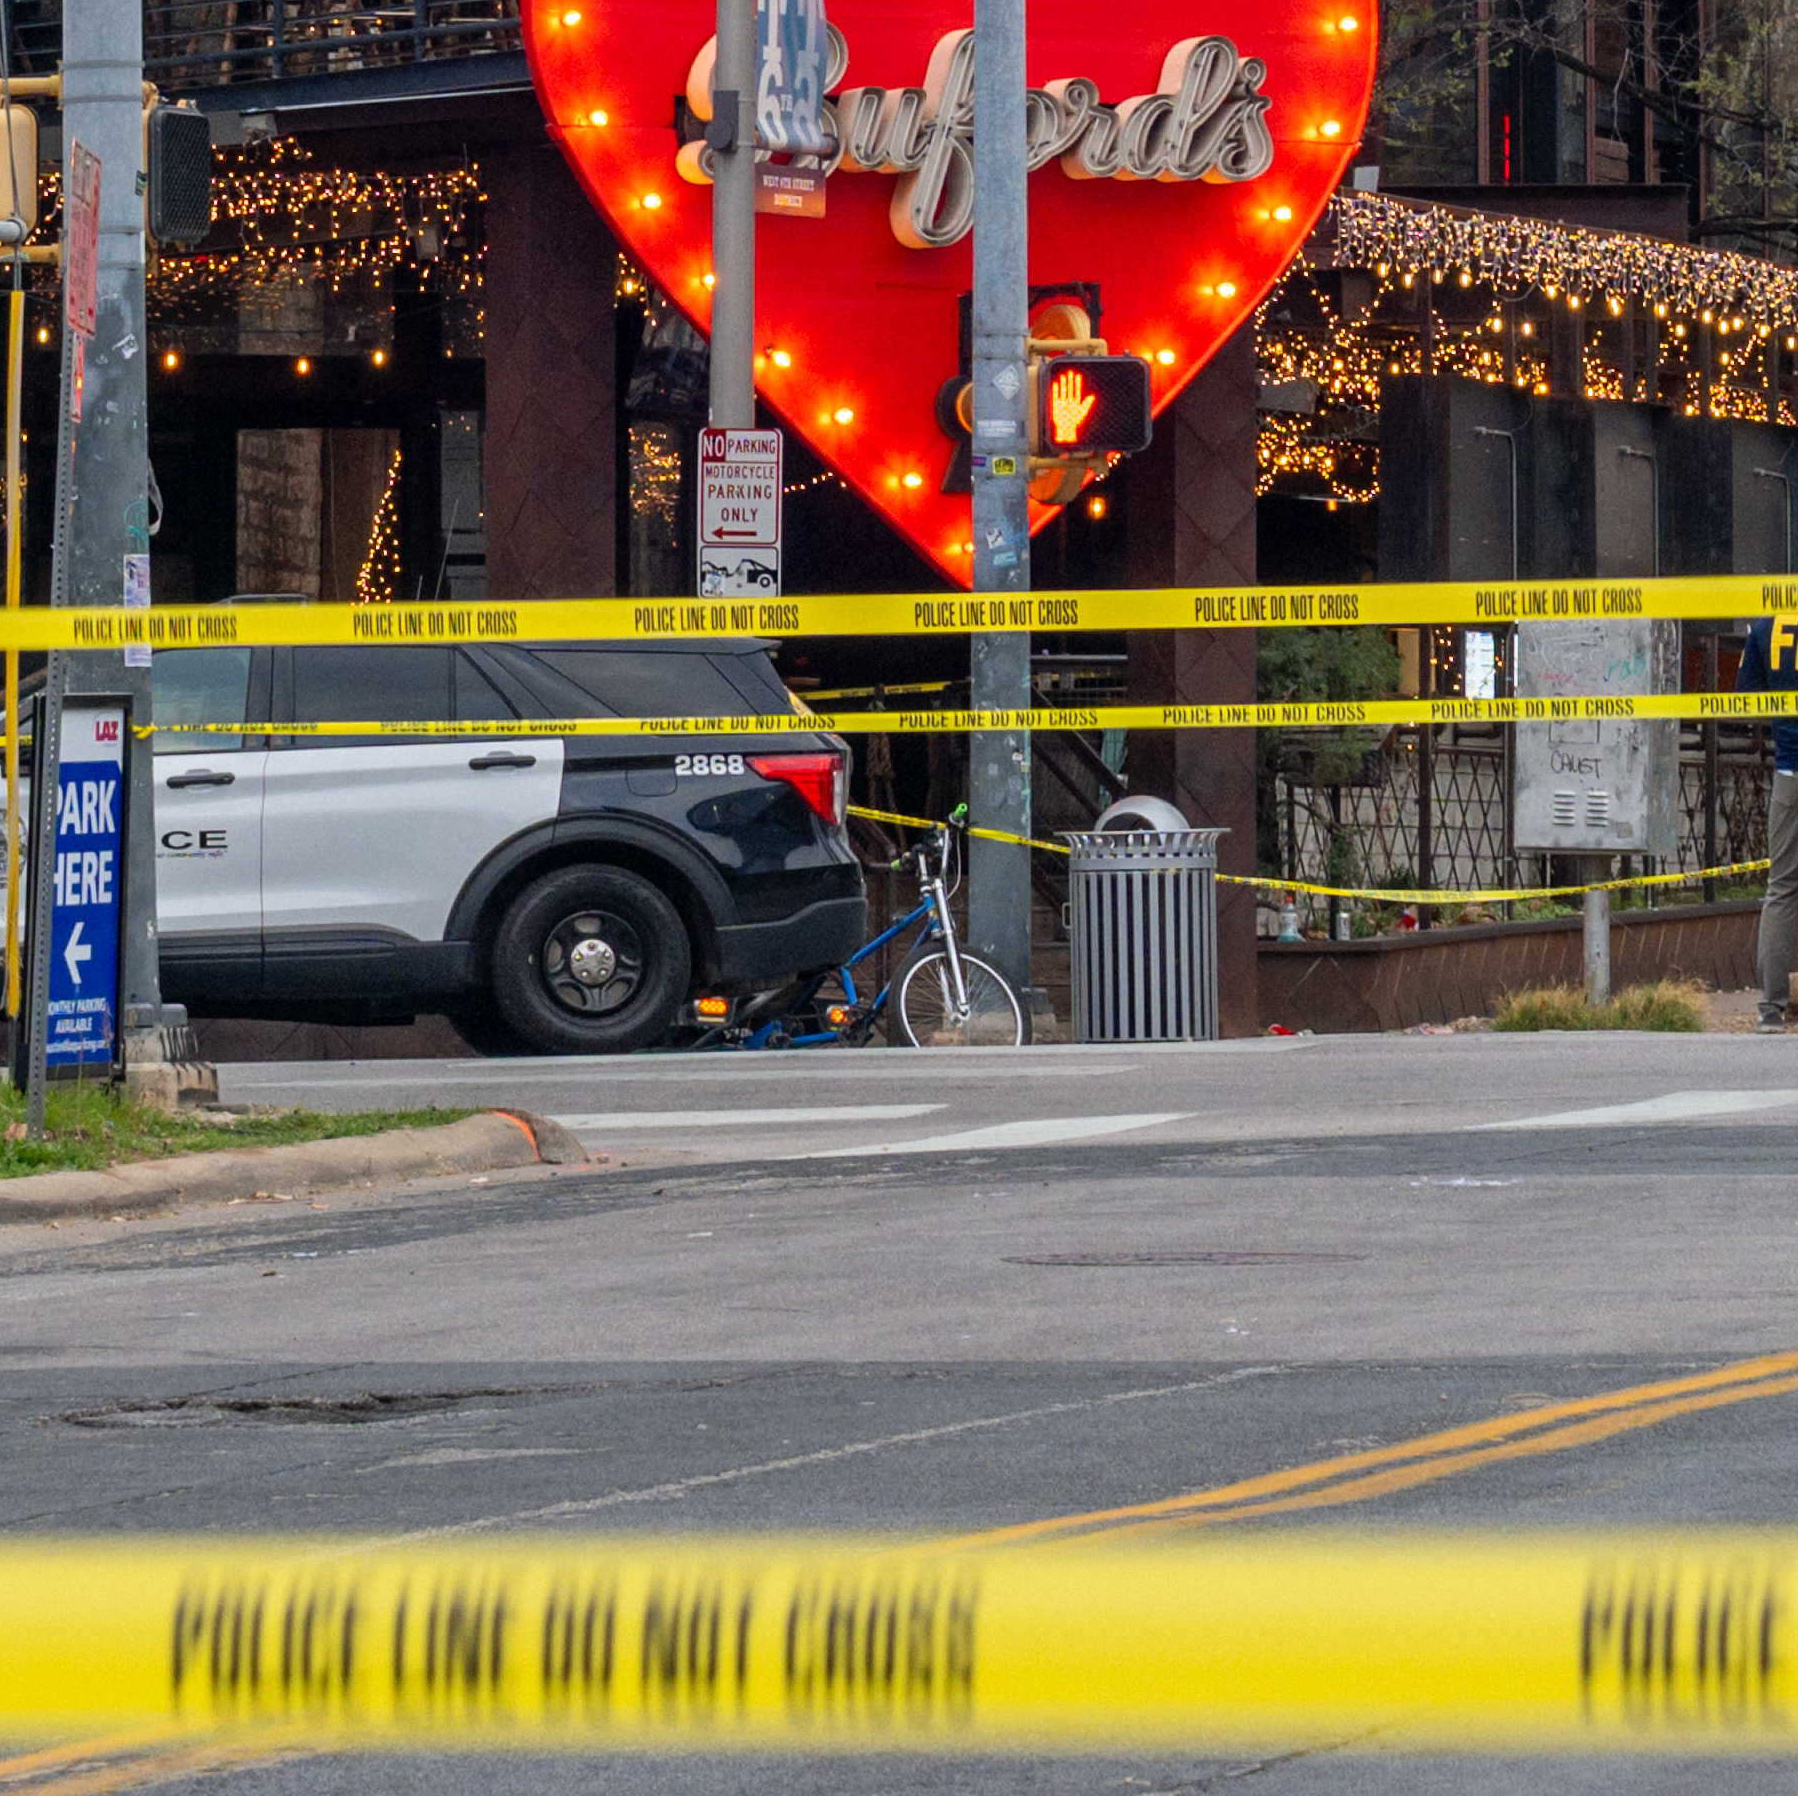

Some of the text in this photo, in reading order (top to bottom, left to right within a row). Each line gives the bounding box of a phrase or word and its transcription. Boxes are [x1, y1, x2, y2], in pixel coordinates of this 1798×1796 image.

[703, 435, 776, 457] NO PARKING
[705, 466, 775, 479] MOTORCYCLE
[708, 484, 772, 499] PARKING
[720, 507, 758, 522] ONLY
[1194, 594, 1359, 621] POLICE LINE DO NOT CROSS
[1475, 588, 1642, 616] POLICE LINE DO NOT CROSS
[353, 611, 517, 638] POLICE LINE DO NOT CROSS
[634, 604, 799, 632] POLICE LINE DO NOT CROSS
[914, 600, 1078, 627] POLICE LINE DO NOT CROSS
[1162, 705, 1366, 724] POLICE LINE DO NOT CROSS
[1431, 698, 1634, 719] POLICE LINE DO NOT CROSS
[1700, 696, 1748, 713] POLICE
[1756, 695, 1786, 712] LINE
[899, 710, 1098, 727] POLICE LINE DO NOT CROSS
[95, 720, 119, 742] LAZ
[674, 754, 744, 776] 2868
